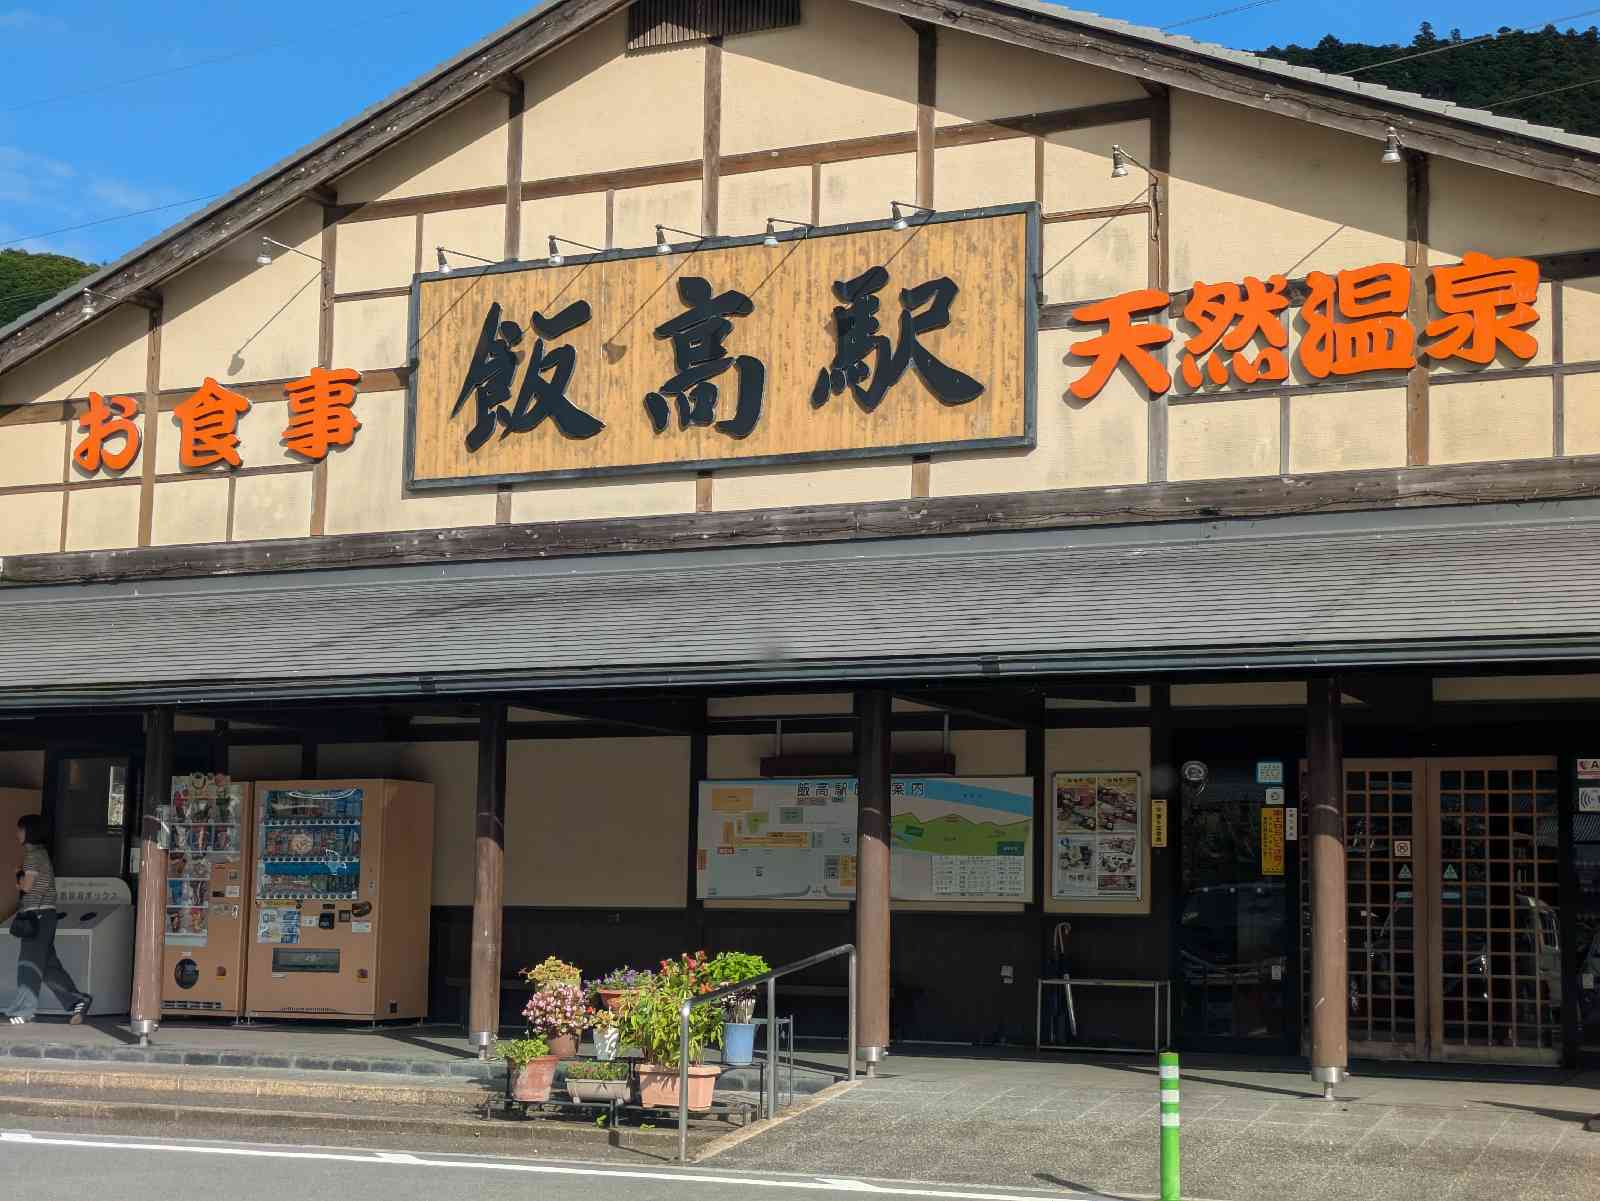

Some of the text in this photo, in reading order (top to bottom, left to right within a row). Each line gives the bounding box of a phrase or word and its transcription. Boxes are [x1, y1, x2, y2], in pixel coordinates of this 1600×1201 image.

[452, 267, 985, 453] 飯高駅
[1070, 252, 1541, 398] 天然温泉
[73, 368, 360, 474] お食事
